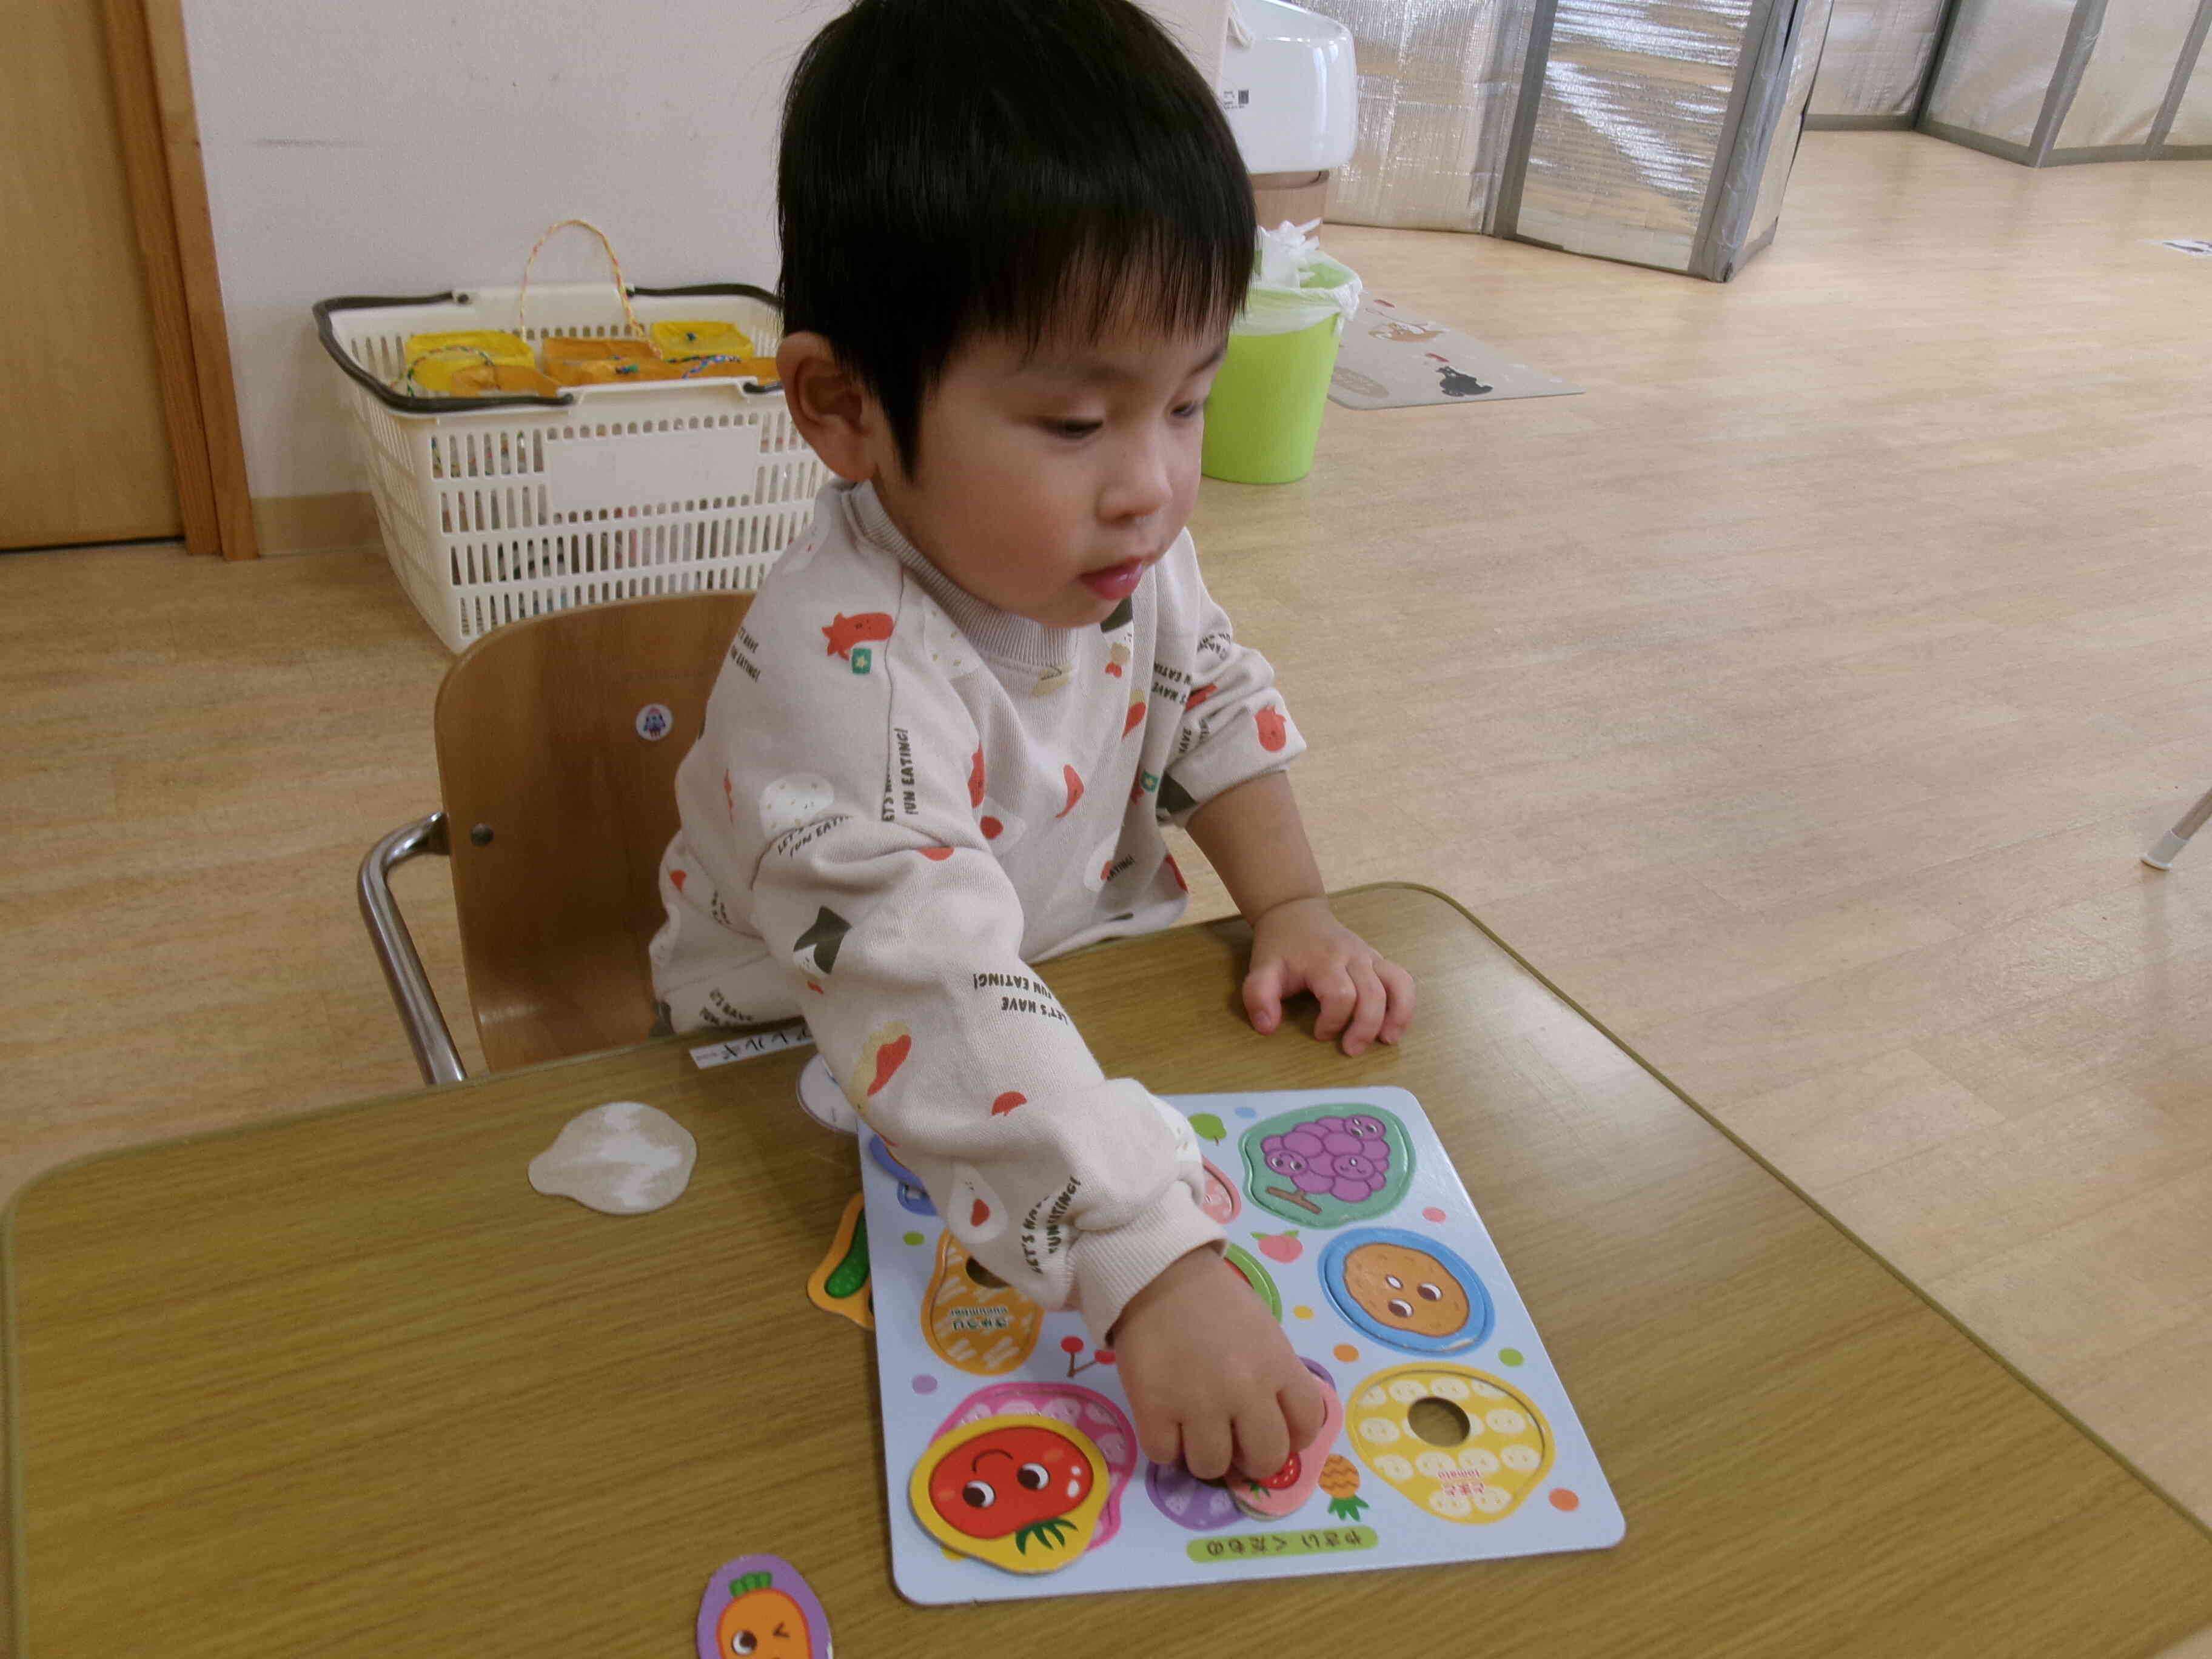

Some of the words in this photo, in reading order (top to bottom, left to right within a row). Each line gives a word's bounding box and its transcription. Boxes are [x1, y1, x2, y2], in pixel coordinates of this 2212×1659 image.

[894, 728, 915, 785] EATING!
[973, 973, 1029, 990] EATING!
[1001, 996, 1036, 1014] HAVE
[1040, 1004, 1068, 1026] LET'S
[1438, 1470, 1481, 1480] tomato
[1442, 1483, 1484, 1496] トマト
[1207, 1534, 1287, 1557] くだもの
[1301, 1529, 1361, 1549] やさい
